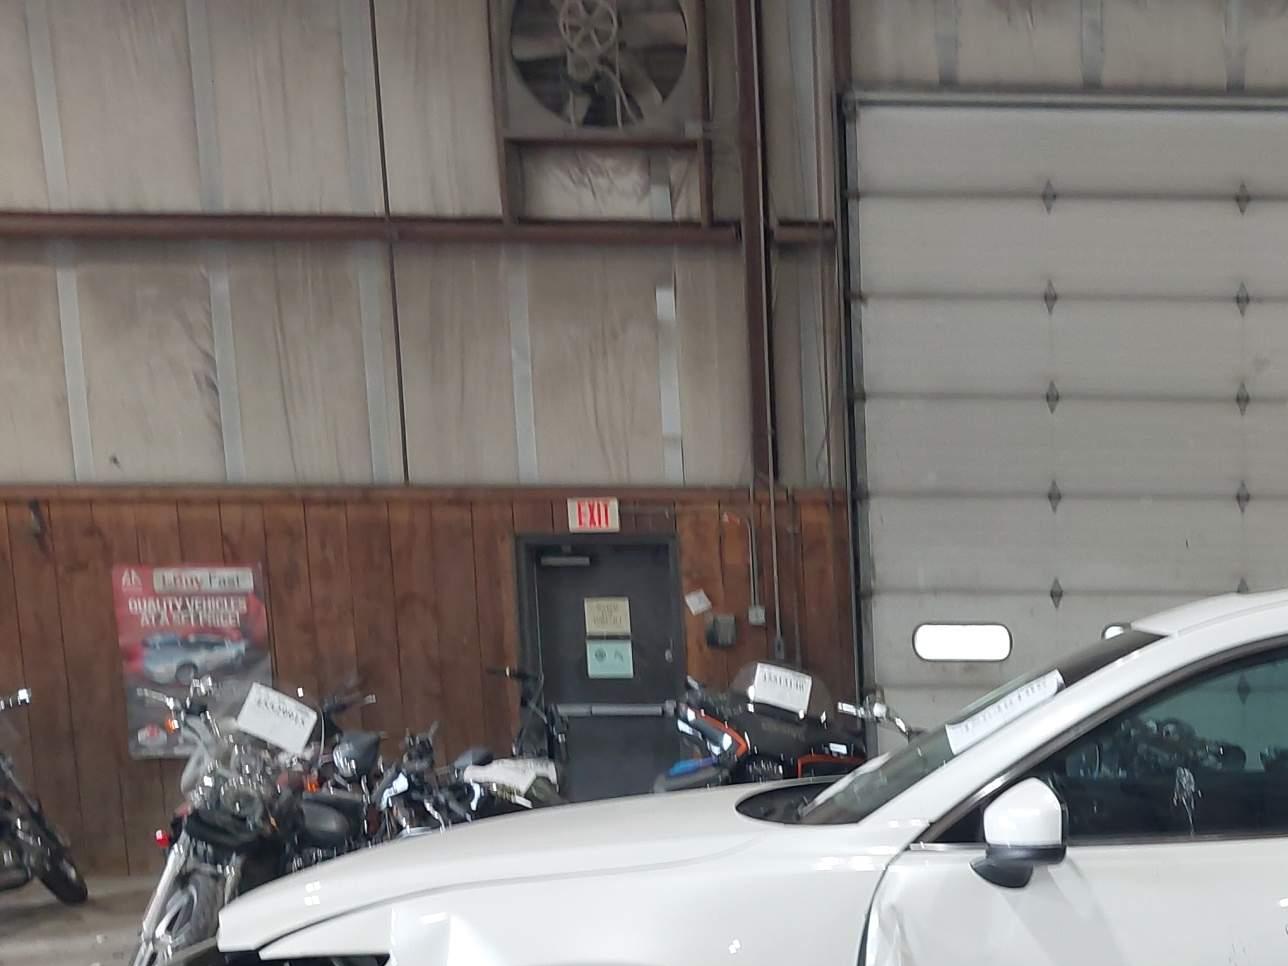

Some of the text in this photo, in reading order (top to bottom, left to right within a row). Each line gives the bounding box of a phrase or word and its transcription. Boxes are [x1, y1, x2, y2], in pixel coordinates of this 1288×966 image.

[576, 501, 610, 529] EXIT
[128, 596, 248, 615] QUALITY VEHICLES
